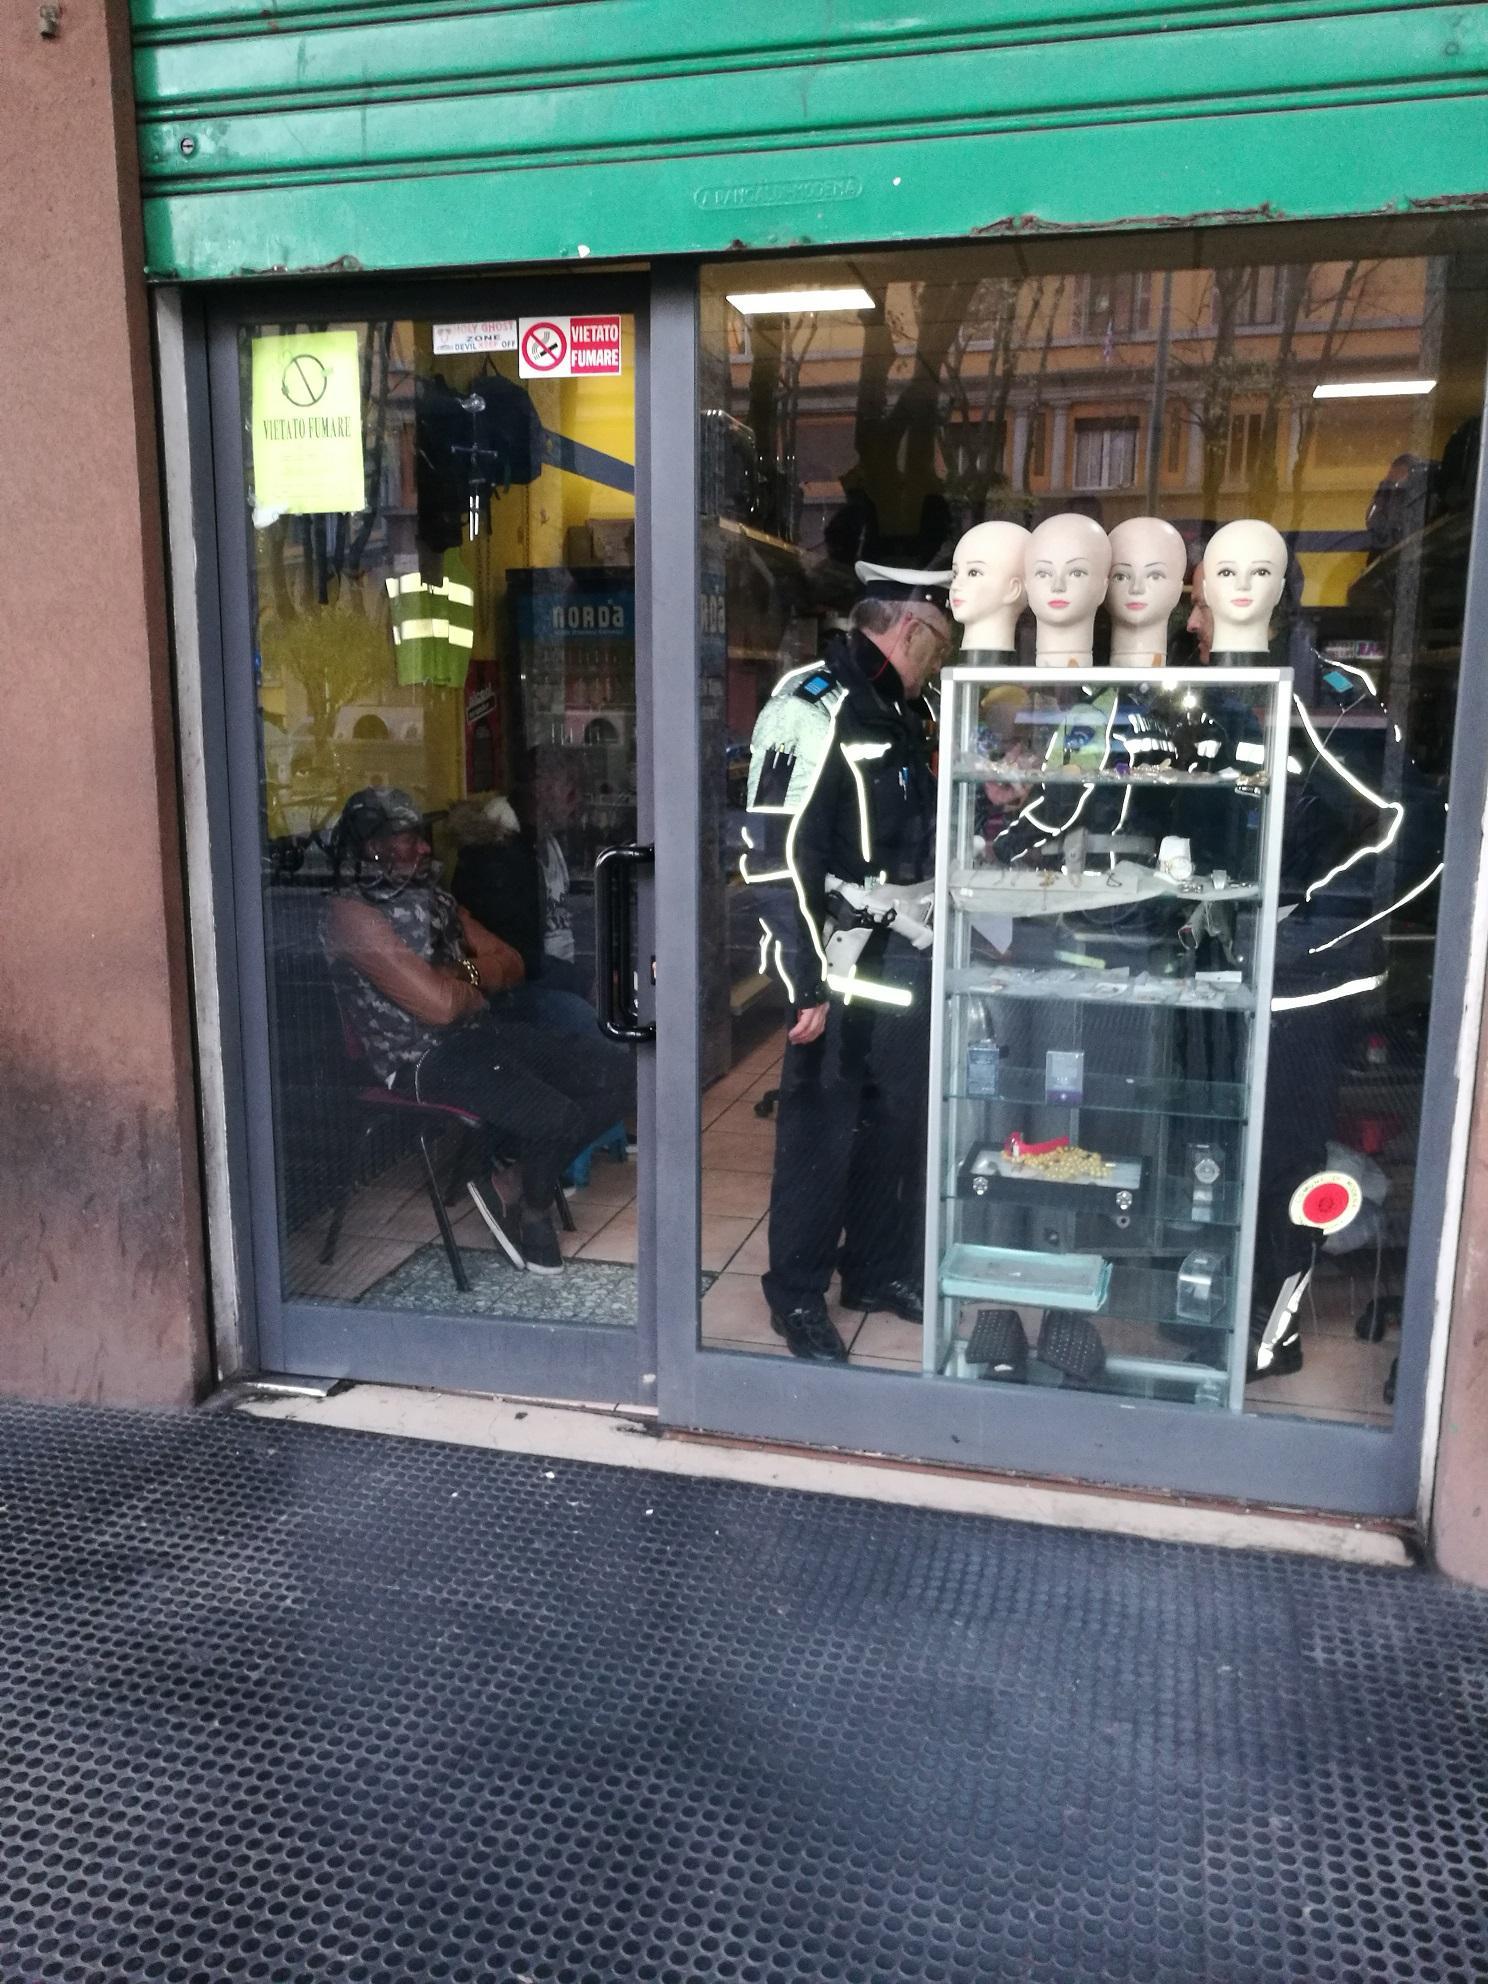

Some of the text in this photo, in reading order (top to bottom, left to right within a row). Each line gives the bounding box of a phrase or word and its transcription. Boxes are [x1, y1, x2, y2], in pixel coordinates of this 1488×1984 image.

[466, 334, 501, 342] ZONE
[571, 324, 618, 343] VIETATO
[454, 343, 477, 351] DEVIL
[501, 340, 515, 348] OFF
[571, 349, 619, 367] FUMARE
[263, 416, 352, 440] VIETATO FUMARE
